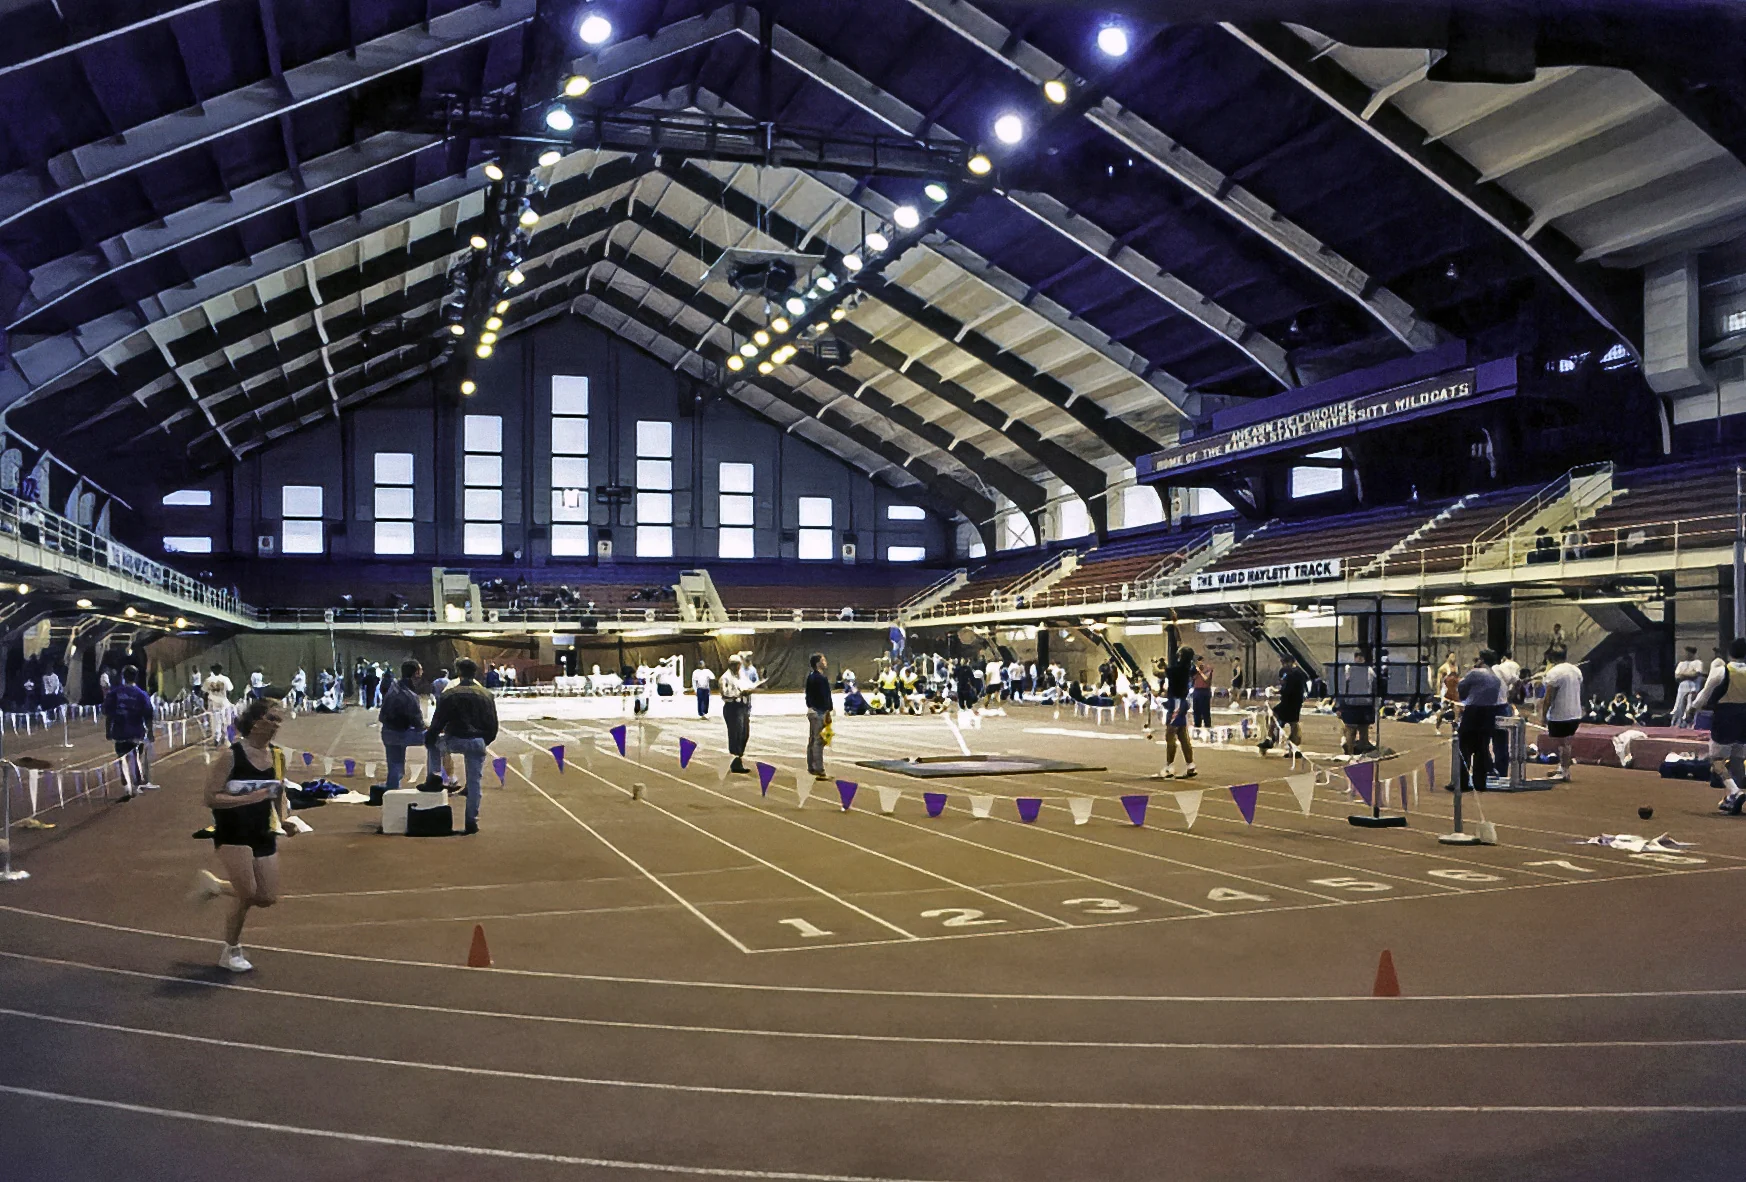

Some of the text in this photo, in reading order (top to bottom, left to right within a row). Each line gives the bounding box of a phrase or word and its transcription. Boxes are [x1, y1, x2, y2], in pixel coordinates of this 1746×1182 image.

[1202, 444, 1221, 459] THE
[1224, 432, 1266, 455] KANSAS
[1268, 421, 1308, 444] STATE
[1310, 402, 1388, 433] UNIVERSITY
[1394, 382, 1469, 412] WILDCATS
[1277, 401, 1355, 432] FIELDHOUSE
[1197, 560, 1332, 587] THE WARD HAYLETT TRACK
[1427, 869, 1505, 881] 6
[1522, 860, 1597, 873] 7
[1307, 877, 1393, 892] 5
[1207, 887, 1275, 902] 4
[1062, 898, 1139, 914] 3
[920, 908, 1007, 926] 2
[778, 918, 834, 938] 1
